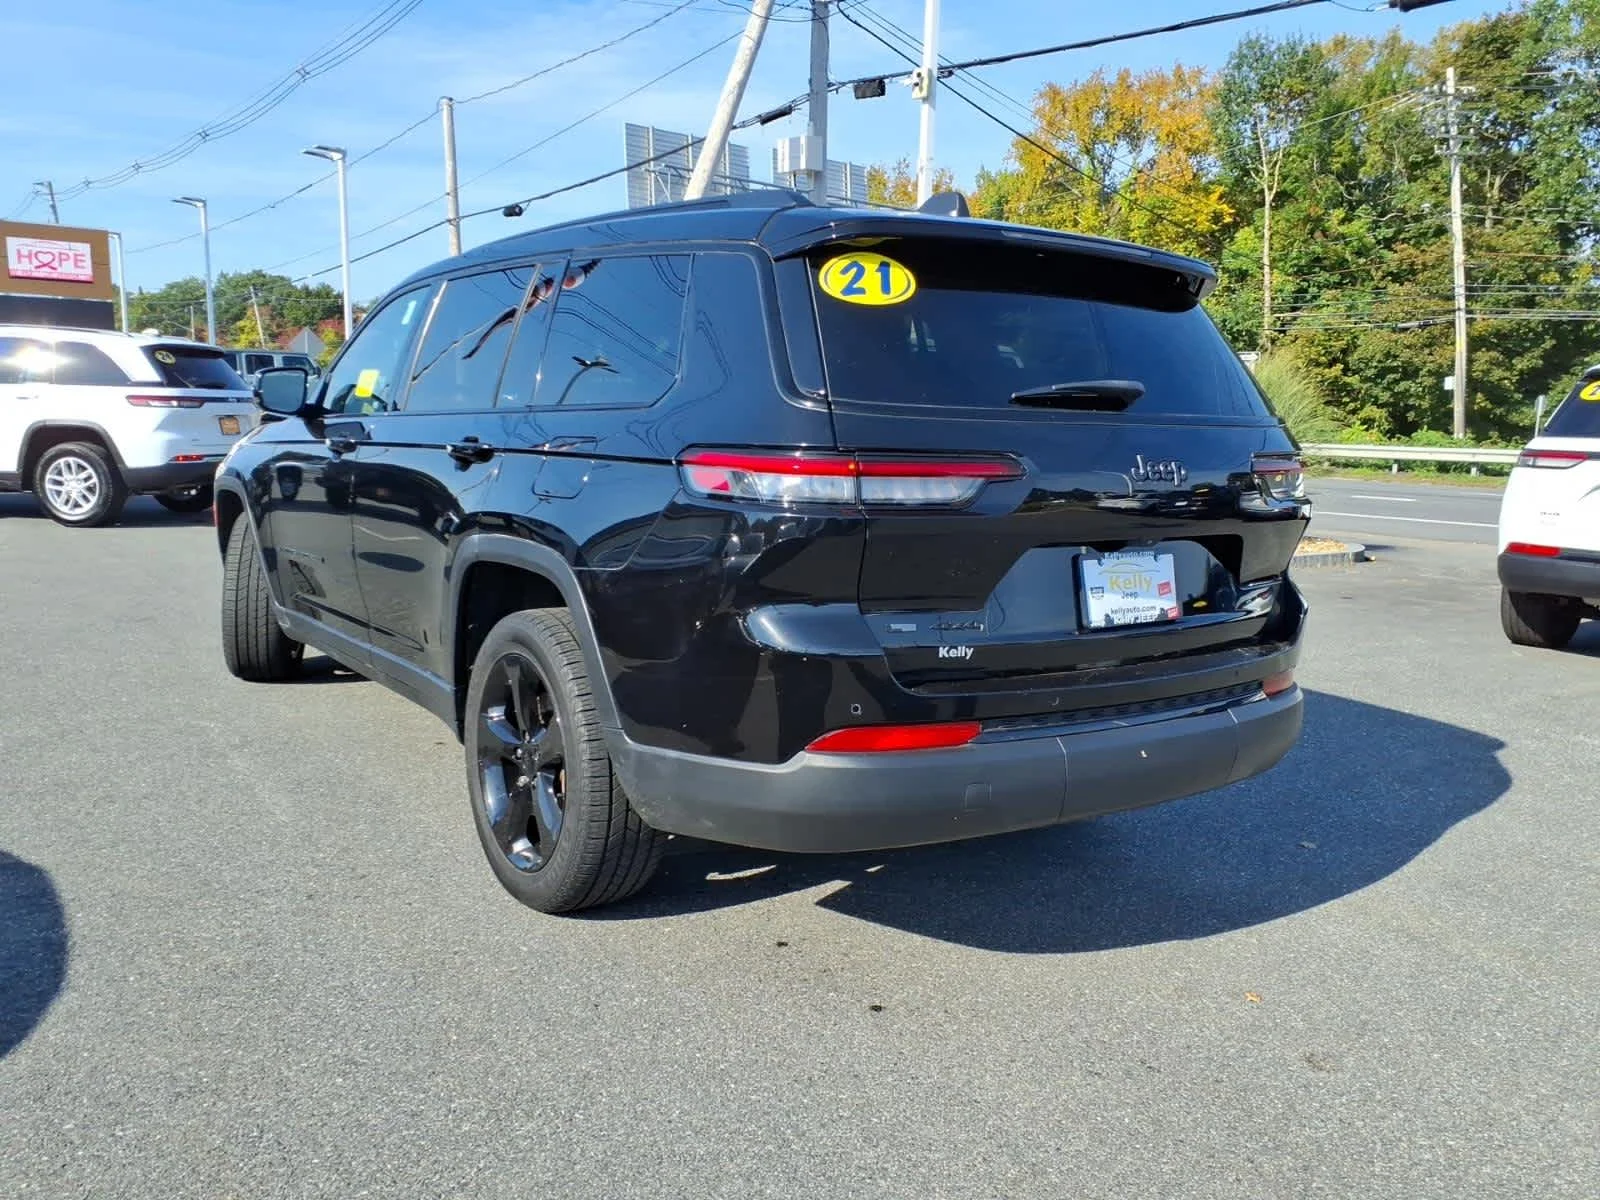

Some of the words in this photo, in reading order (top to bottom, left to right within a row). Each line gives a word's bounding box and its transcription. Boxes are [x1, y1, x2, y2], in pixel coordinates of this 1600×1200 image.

[840, 261, 892, 296] 21
[1131, 454, 1188, 486] Jeep
[1109, 573, 1152, 592] Kelly
[1121, 591, 1138, 600] Jeep
[1111, 605, 1157, 615] kellyauto.com
[938, 646, 974, 660] Kelly
